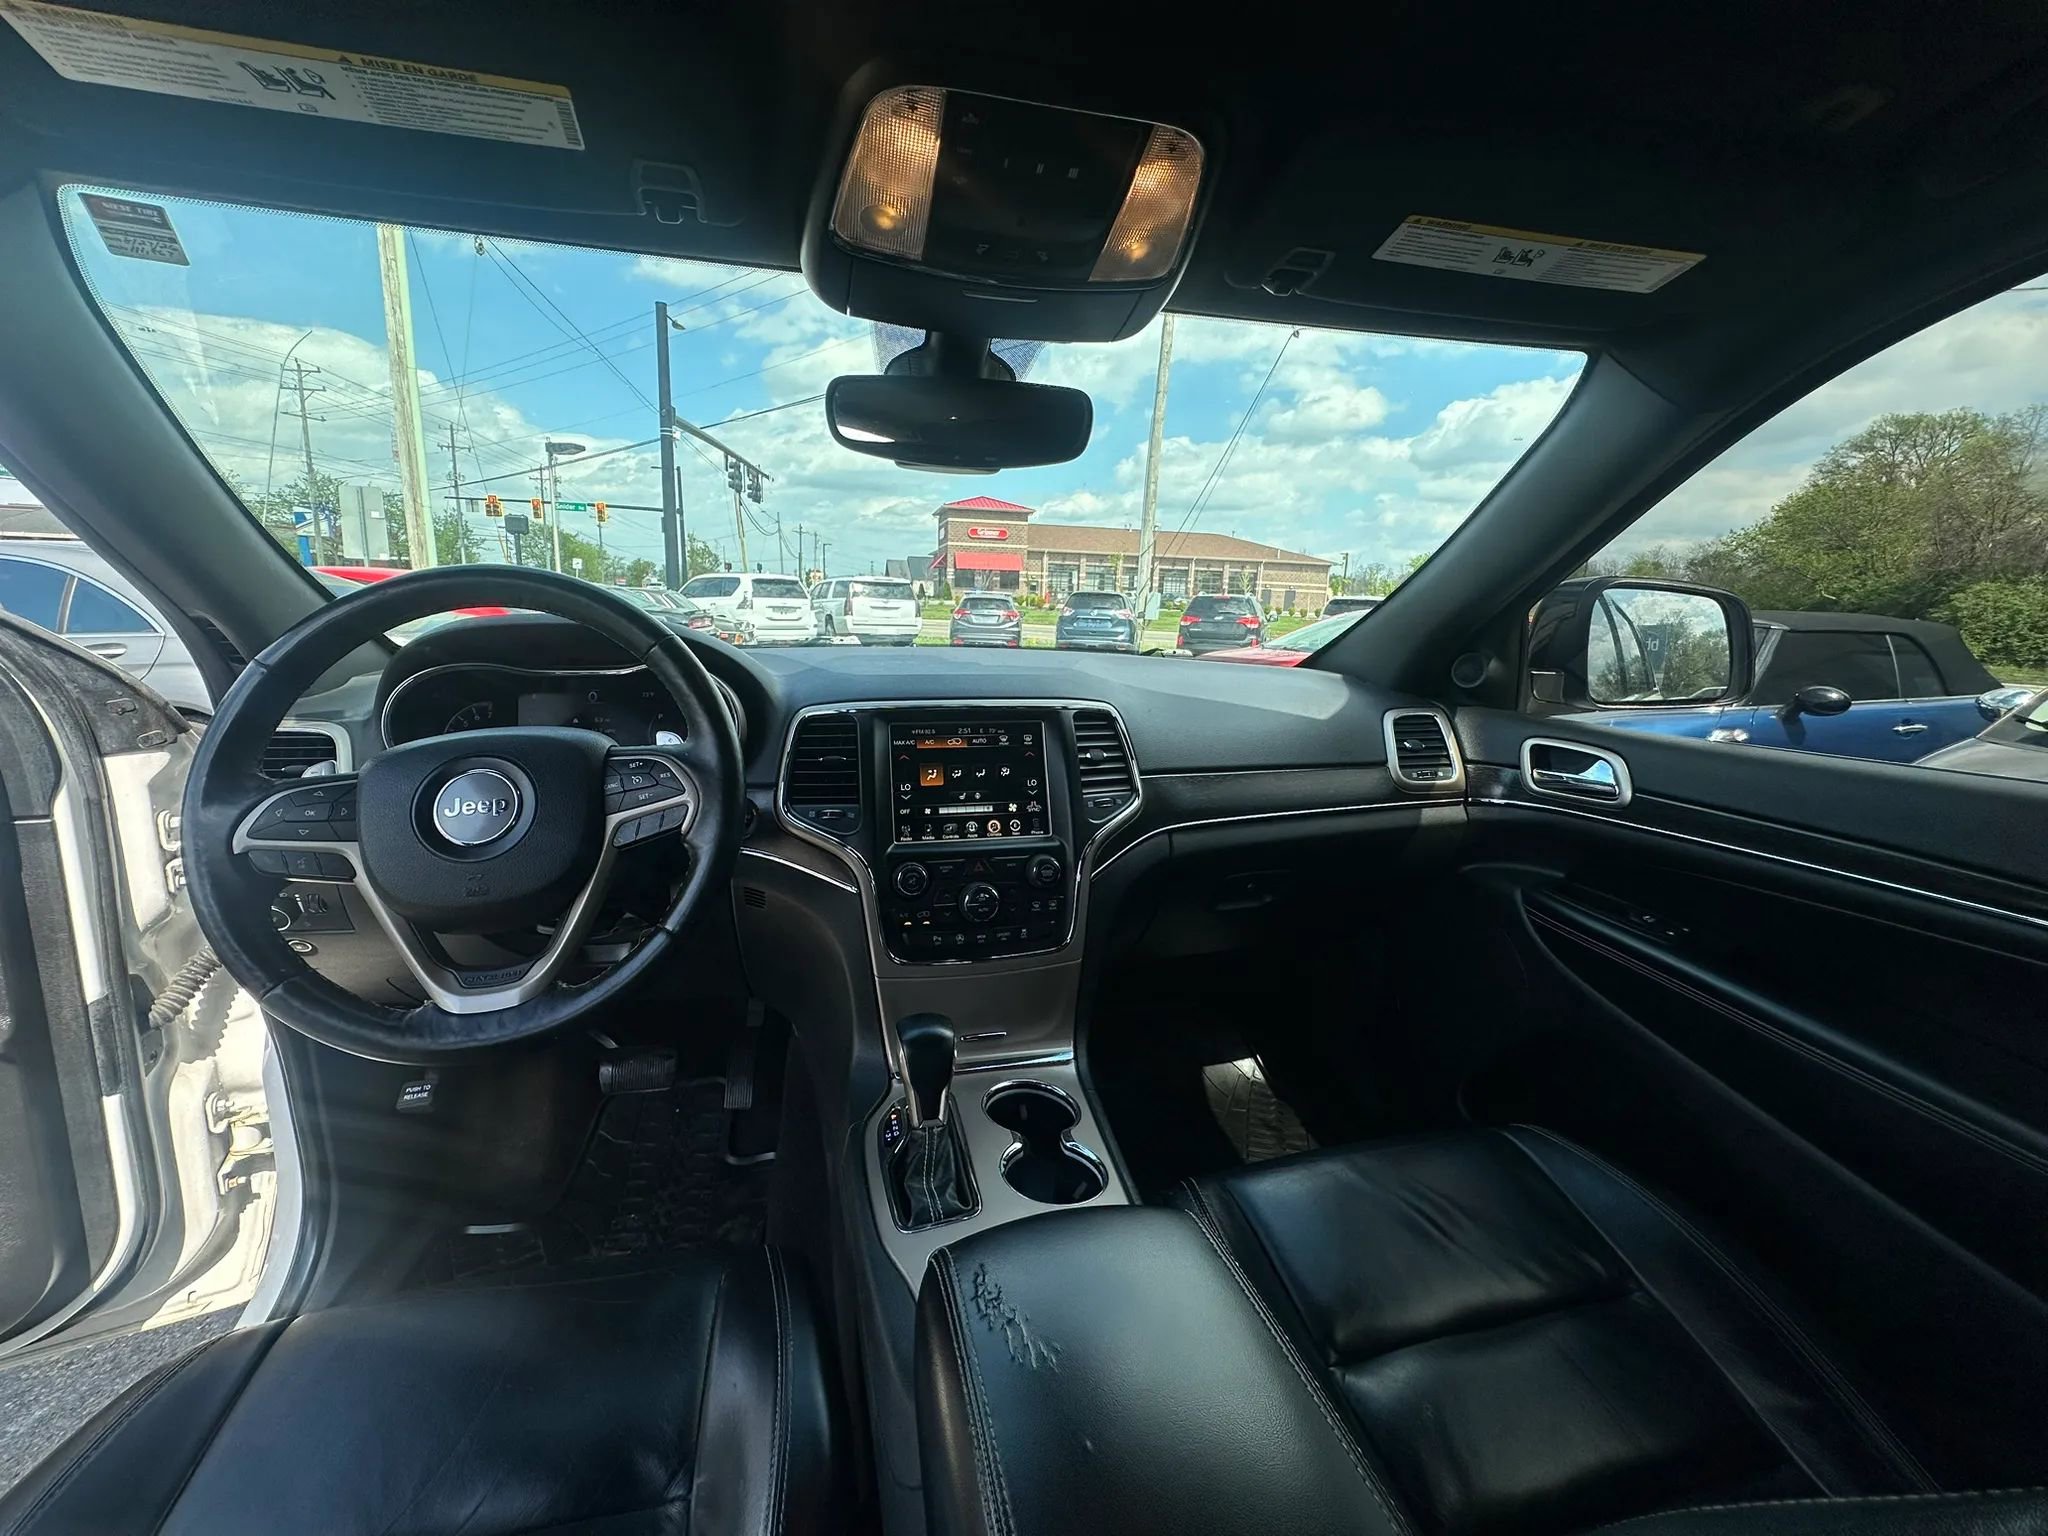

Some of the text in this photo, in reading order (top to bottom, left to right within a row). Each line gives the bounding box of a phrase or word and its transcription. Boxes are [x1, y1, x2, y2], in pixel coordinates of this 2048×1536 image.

[360, 56, 478, 82] MISE EN GARDE
[900, 783, 911, 791] LO
[1027, 779, 1037, 787] LO
[444, 797, 508, 818] Jeep
[403, 1091, 429, 1101] RELEASE
